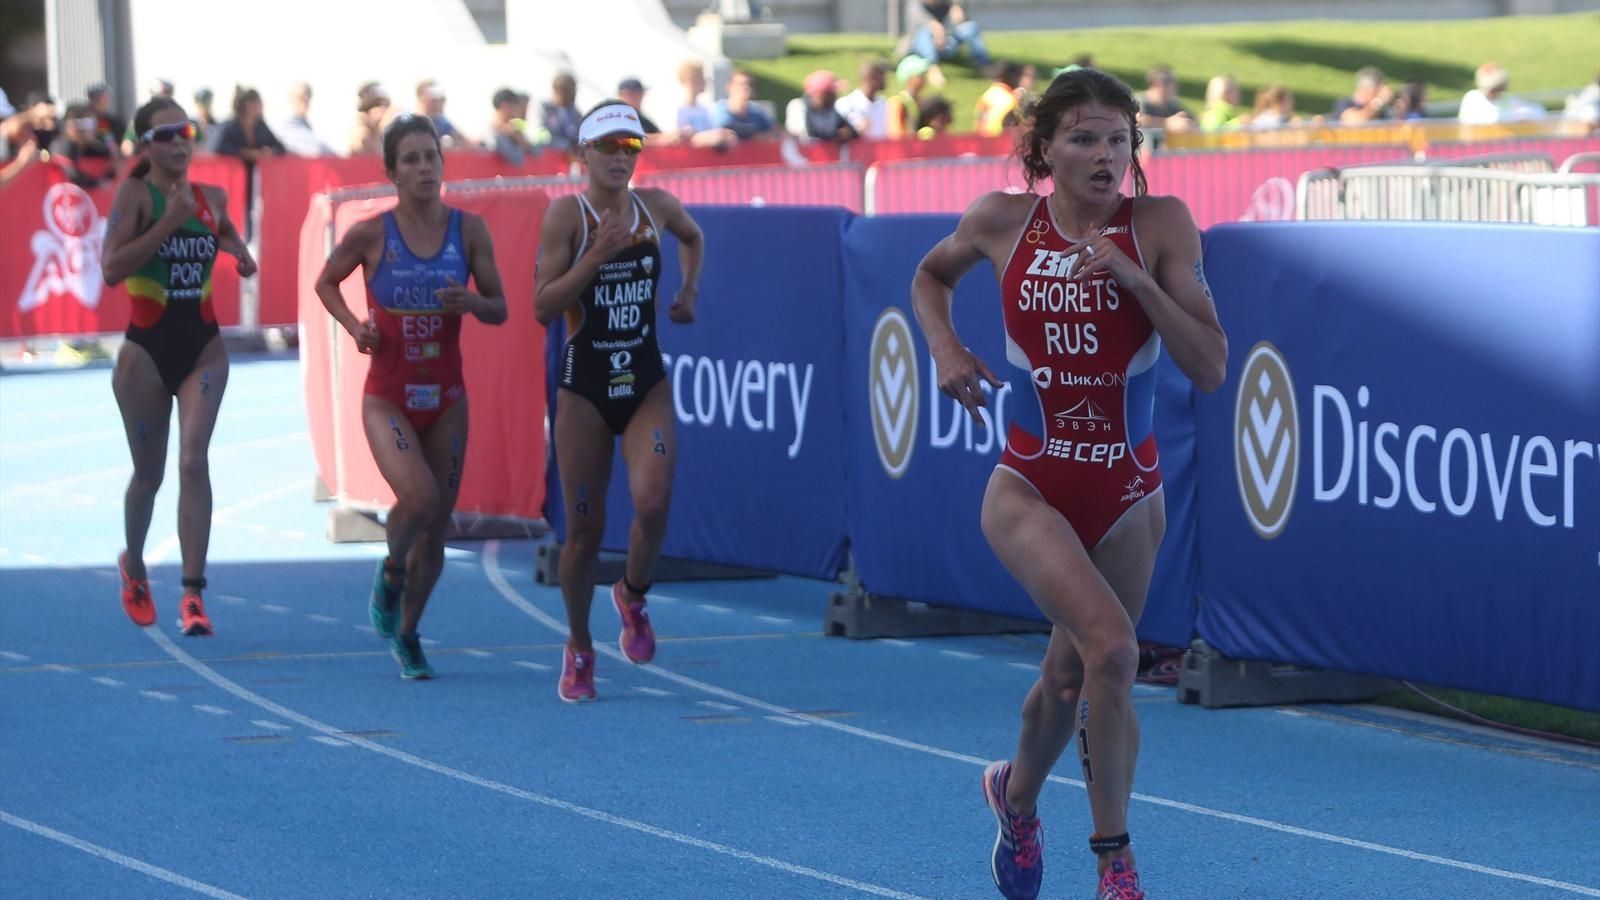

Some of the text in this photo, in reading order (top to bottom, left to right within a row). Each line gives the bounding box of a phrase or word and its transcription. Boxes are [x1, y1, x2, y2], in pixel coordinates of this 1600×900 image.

[158, 235, 216, 258] SANTOS
[170, 262, 204, 286] POR
[594, 278, 653, 306] KLAMER
[1018, 276, 1121, 314] SHORETS
[402, 315, 443, 338] ESP
[608, 304, 641, 331] NED
[1044, 322, 1099, 355] RUS
[653, 442, 666, 455] 4
[1074, 442, 1126, 469] cep
[1313, 384, 1600, 528] Discover
[575, 502, 588, 515] 4
[1079, 727, 1094, 783] 11
